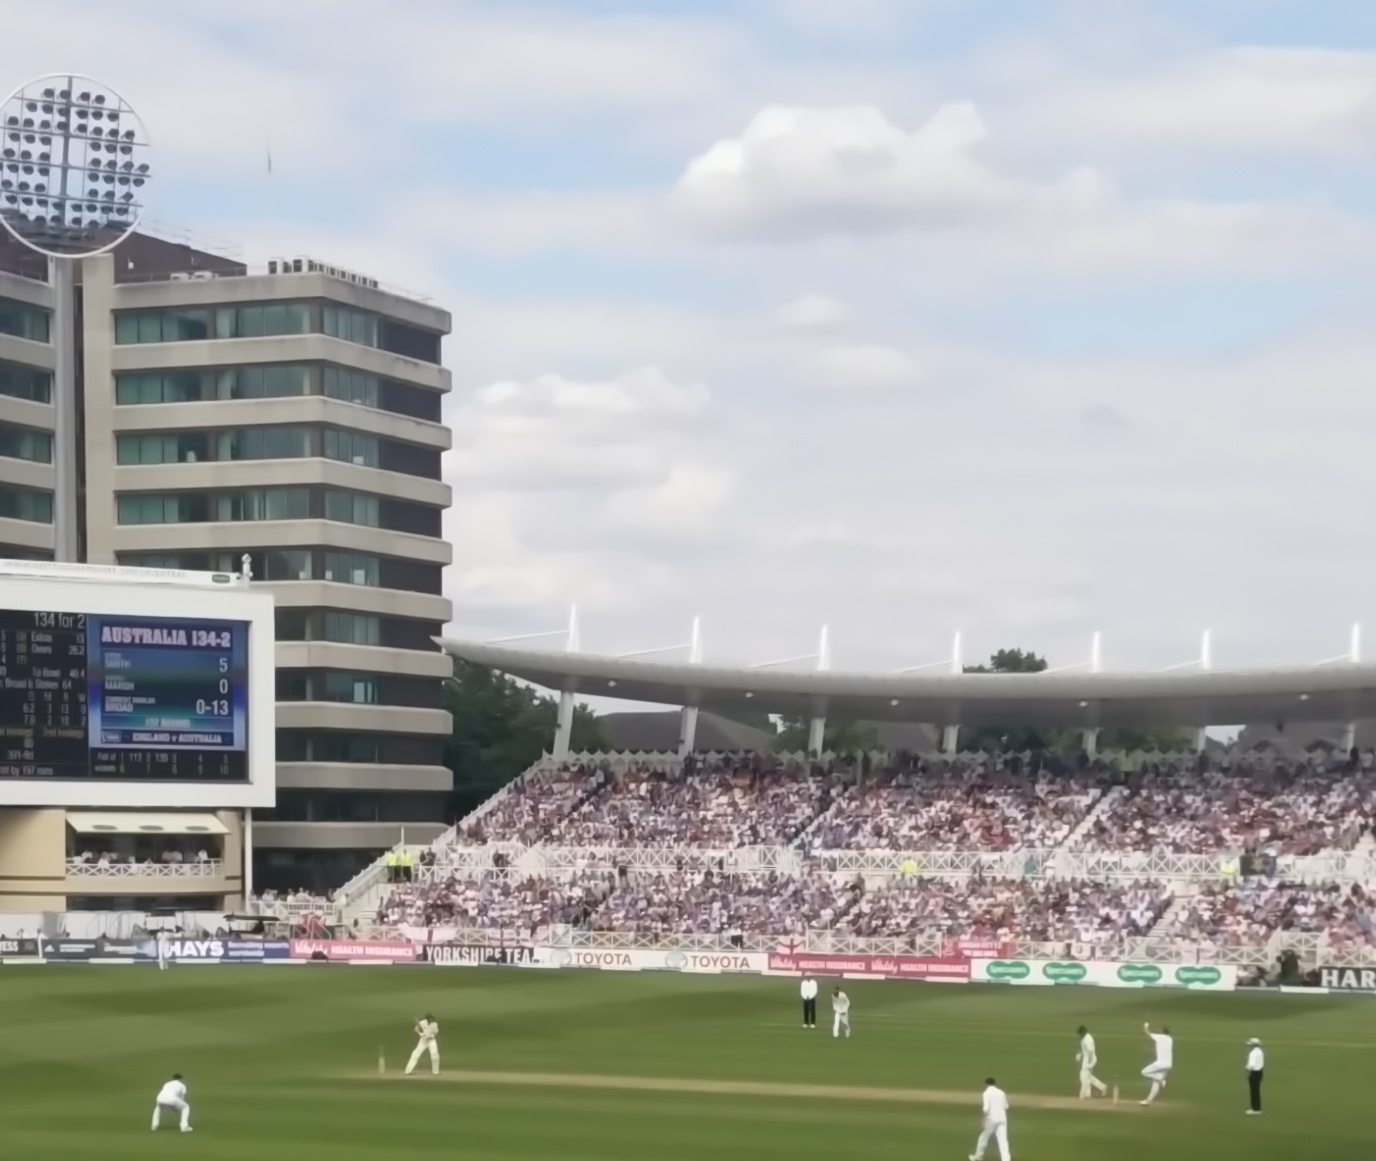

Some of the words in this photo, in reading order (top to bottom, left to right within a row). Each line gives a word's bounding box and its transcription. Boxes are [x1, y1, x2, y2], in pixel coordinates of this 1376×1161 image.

[33, 612, 55, 627] 134
[58, 614, 74, 628] for
[77, 614, 85, 629] 2
[102, 626, 187, 646] AUSTRALIA
[192, 631, 231, 648] 134-2
[219, 658, 228, 672] 5
[219, 679, 228, 694] 0
[196, 699, 229, 715] 0-13
[169, 940, 224, 957] HAYS
[505, 948, 533, 963] TEA
[575, 952, 632, 965] TOYOTA
[691, 955, 750, 968] TOYOTA
